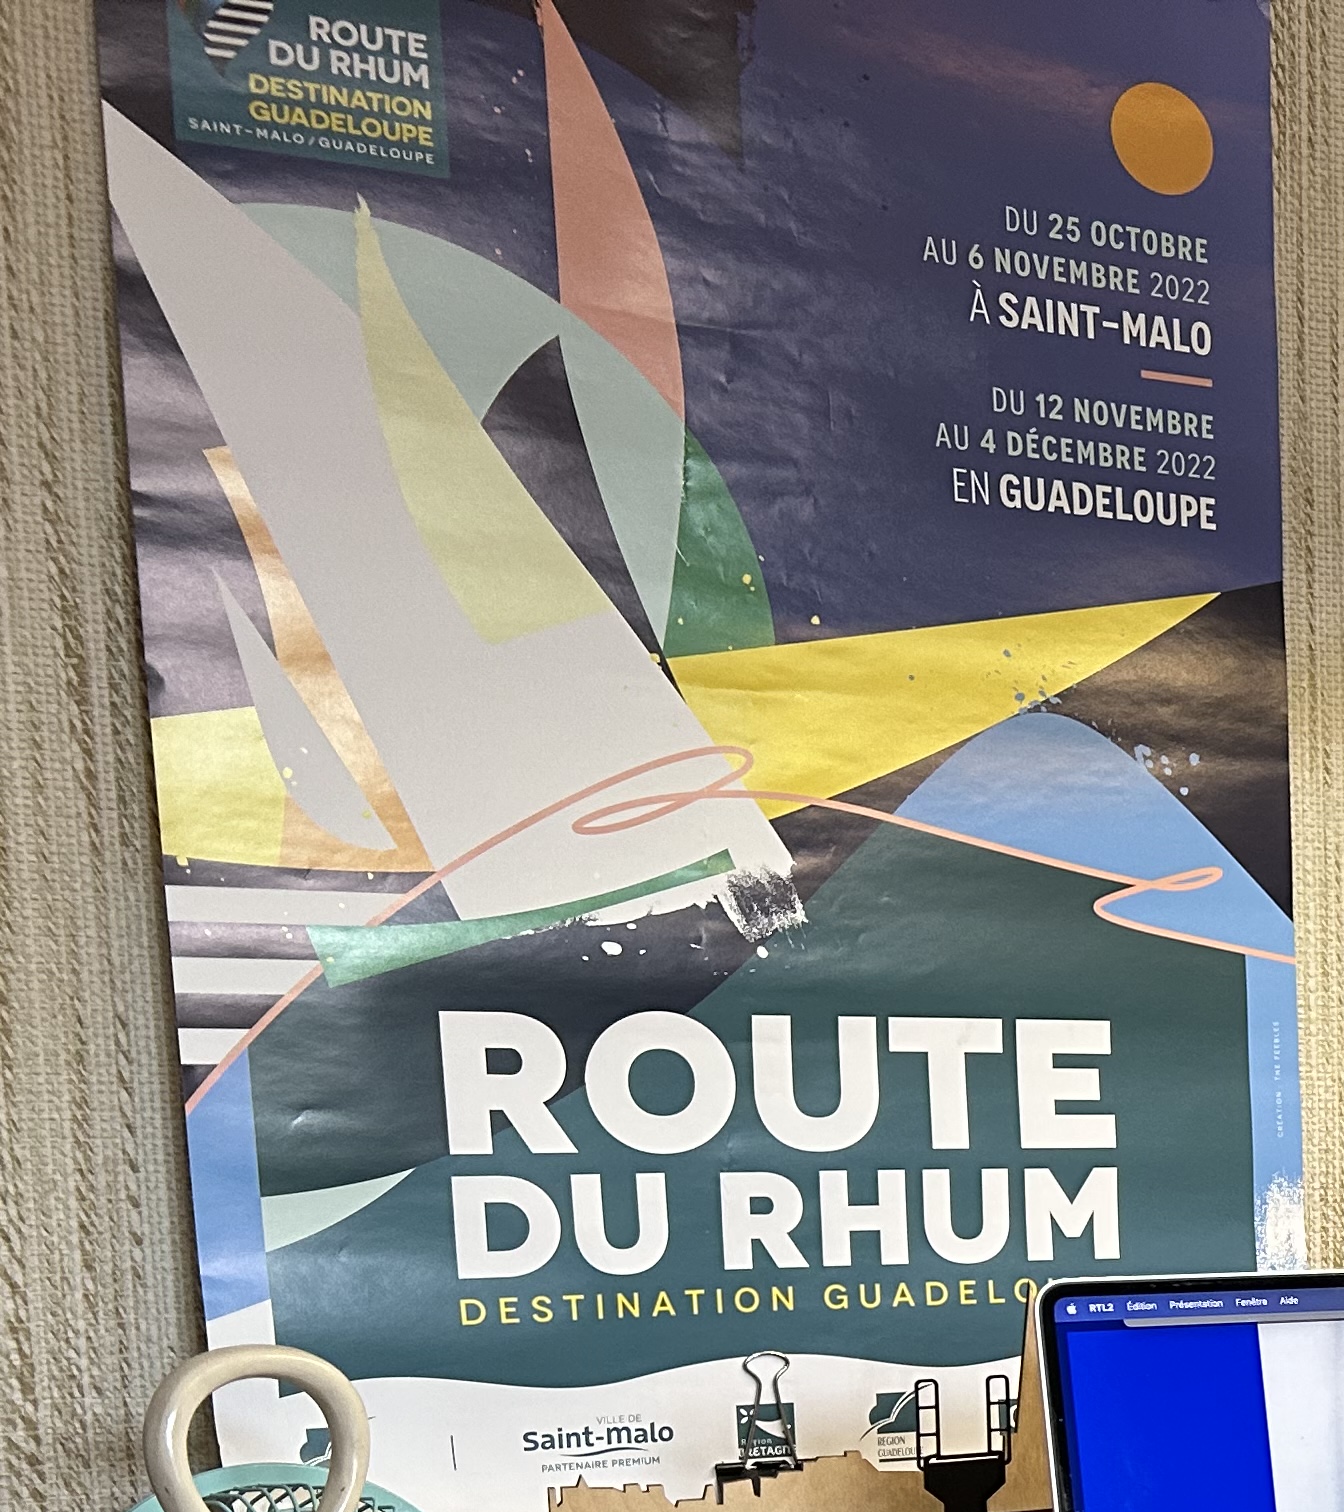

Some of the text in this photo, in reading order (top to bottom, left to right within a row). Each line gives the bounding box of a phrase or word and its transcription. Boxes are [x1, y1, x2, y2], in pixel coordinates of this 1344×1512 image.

[309, 15, 428, 59] ROUTE
[268, 39, 430, 90] DU RHUM
[249, 73, 432, 120] DESTINATION
[249, 101, 434, 146] GUADELOUPE
[1006, 205, 1208, 264] DU 25 OCTOBRE
[923, 236, 1210, 305] AU 6 NOVEMBRE 2022
[970, 280, 1212, 356] À SAINT-MALO
[992, 387, 1214, 439] DU 12 NOVEMBRE
[935, 423, 1216, 480] AU 4 DÉCEMBRE 2022
[953, 468, 1217, 531] EN GUADELOUPE
[438, 1011, 1116, 1155] ROUTE
[451, 1166, 1120, 1279] DU RHUM
[459, 1277, 1038, 1326] DESTINATION GUADELO
[1170, 1299, 1223, 1309] Présentation
[1280, 1296, 1298, 1305] Aide
[522, 1422, 674, 1452] Saint-malo
[596, 1413, 642, 1425] VILLE DE
[541, 1456, 660, 1472] PARTENAIRE PREMIUM
